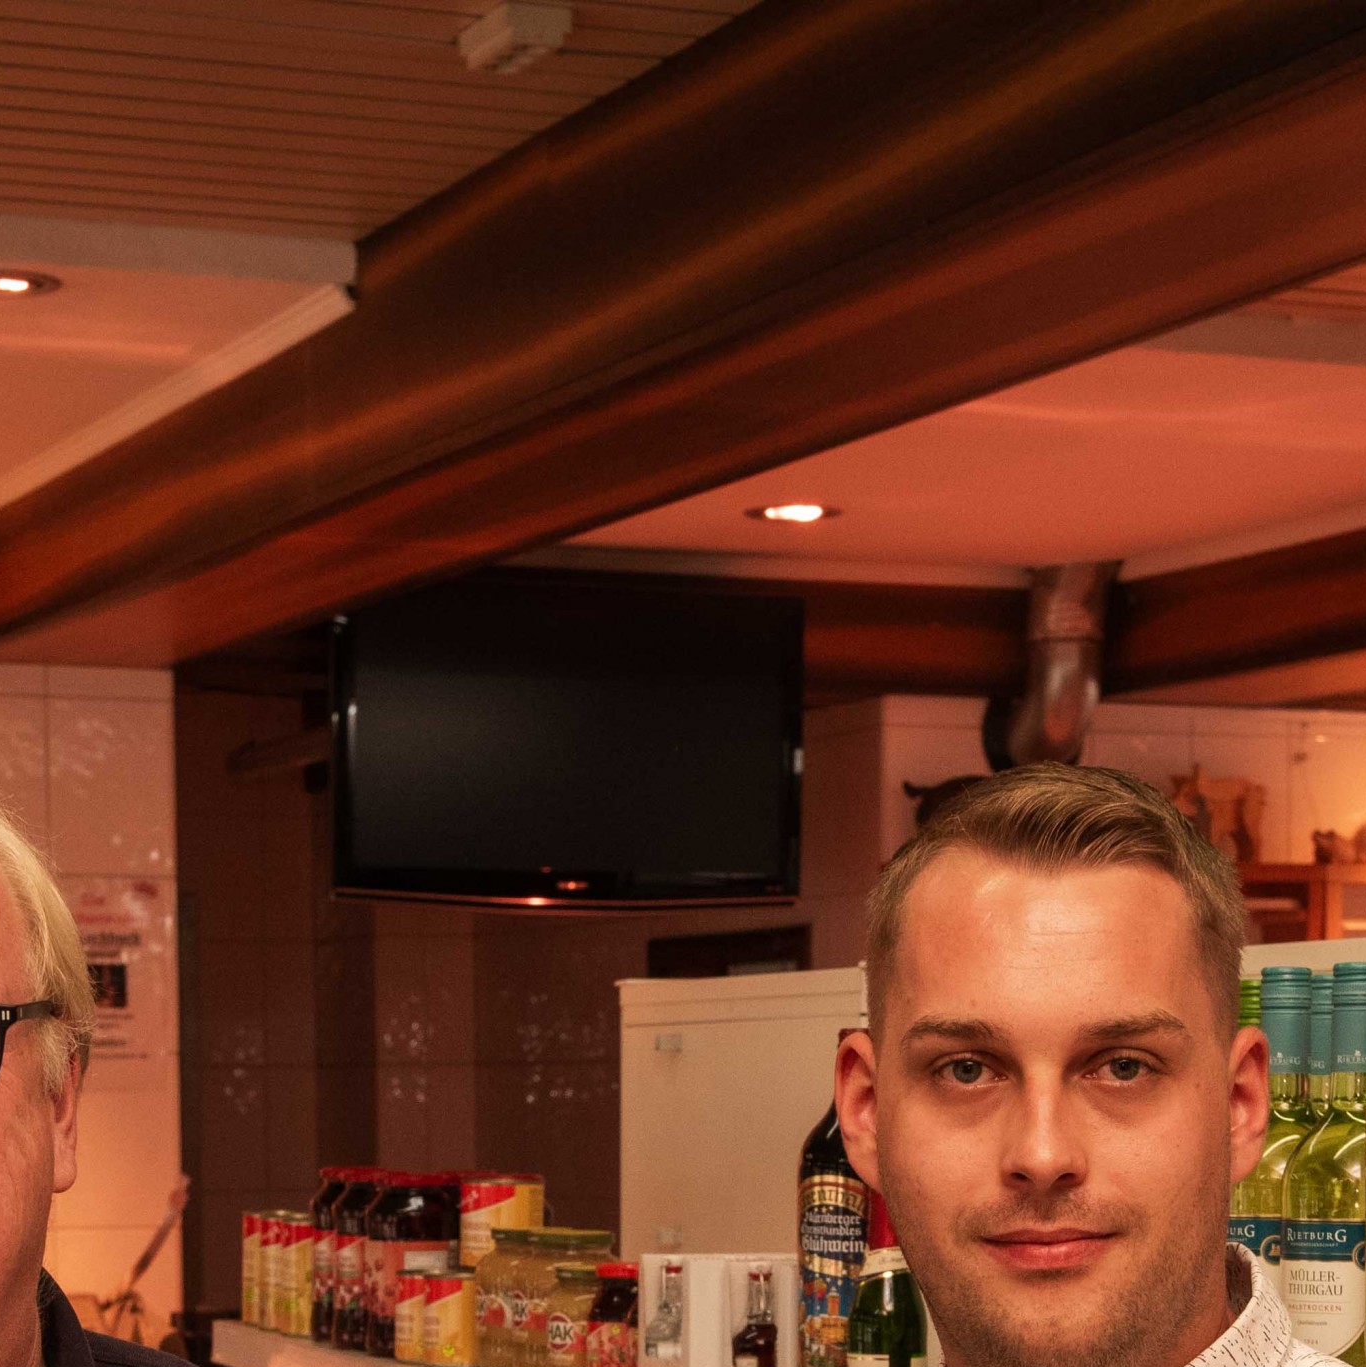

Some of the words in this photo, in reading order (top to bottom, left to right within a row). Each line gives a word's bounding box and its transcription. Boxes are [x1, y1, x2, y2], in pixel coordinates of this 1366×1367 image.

[1286, 1227, 1348, 1243] RIETBURG
[1290, 1267, 1341, 1282] MÜLLER-
[1288, 1283, 1344, 1297] THURGAU
